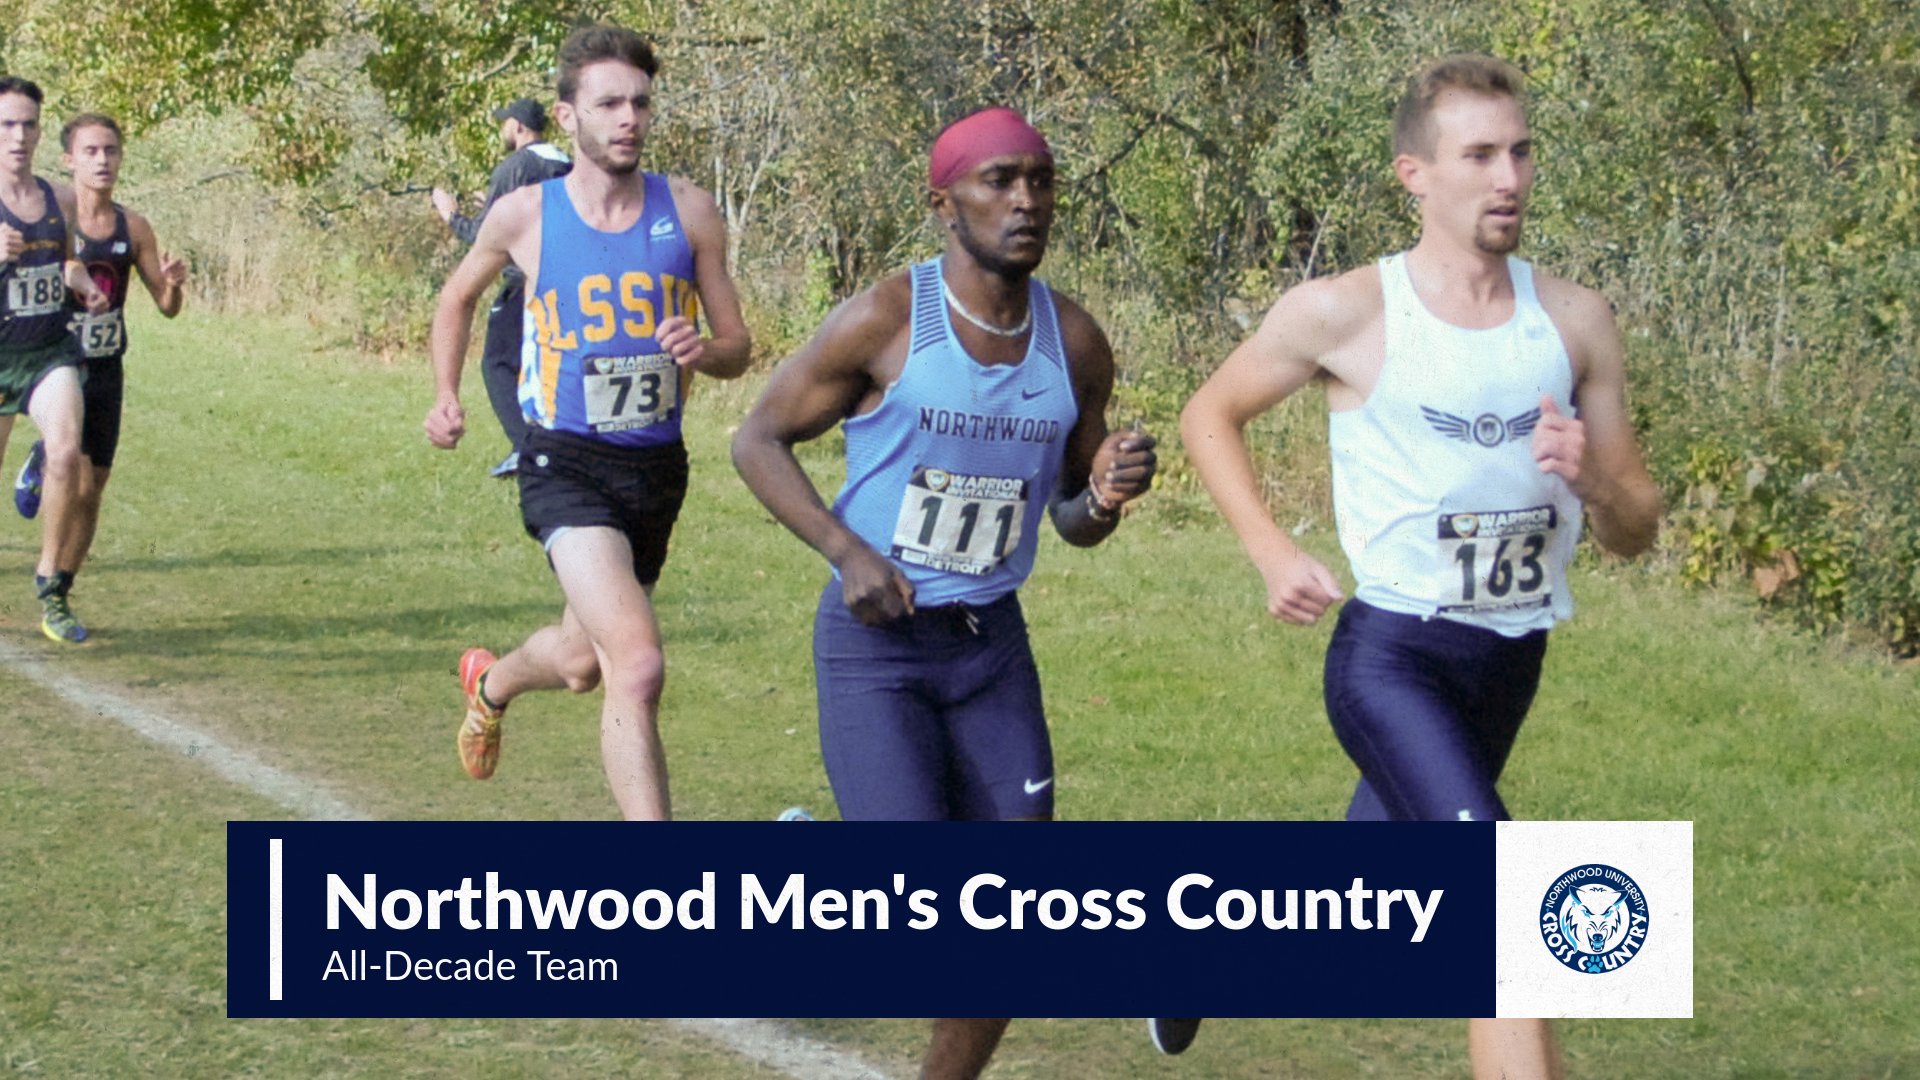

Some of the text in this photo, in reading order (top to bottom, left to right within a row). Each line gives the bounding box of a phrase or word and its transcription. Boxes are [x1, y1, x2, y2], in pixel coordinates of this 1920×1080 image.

[18, 275, 62, 306] 188
[609, 373, 661, 416] 73
[919, 407, 1059, 444] NORTHWOOD
[949, 473, 1023, 491] WARRIOR
[918, 496, 1014, 557] 111
[1454, 533, 1545, 600] 163
